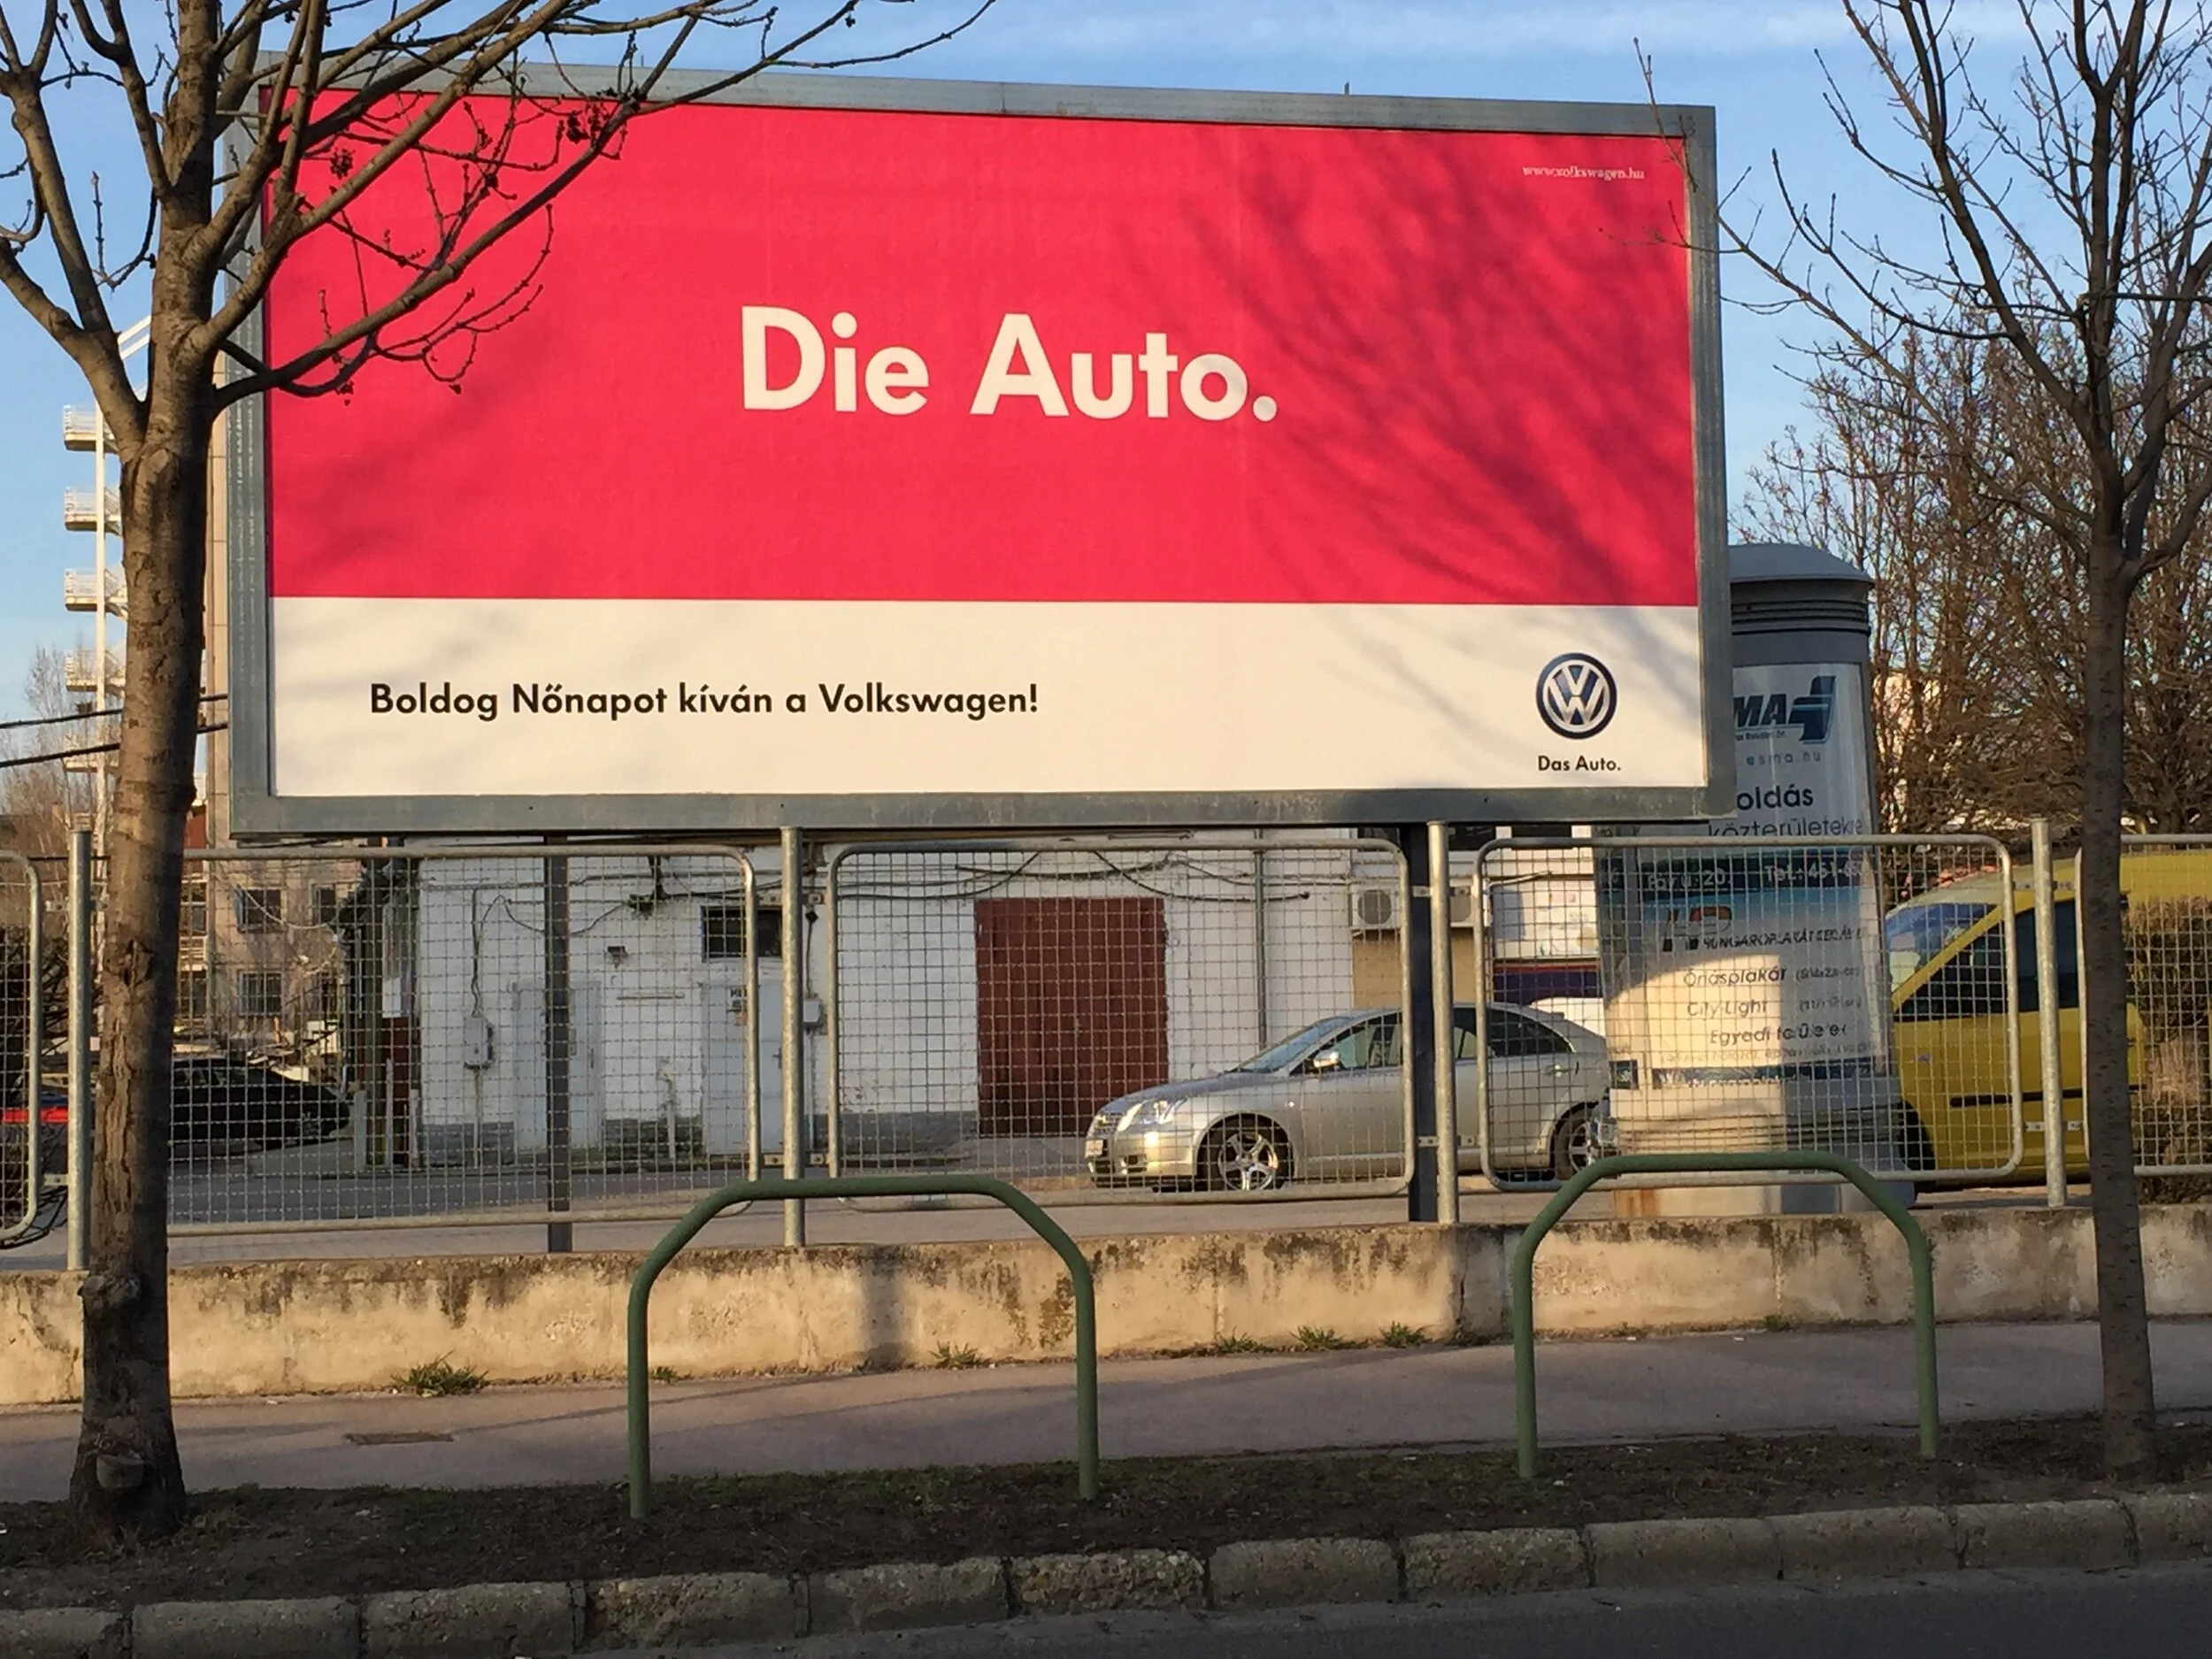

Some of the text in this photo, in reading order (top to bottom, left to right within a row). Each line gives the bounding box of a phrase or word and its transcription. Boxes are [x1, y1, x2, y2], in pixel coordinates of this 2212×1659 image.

[741, 305, 1278, 422] Die Auto.
[371, 680, 1038, 722] Boldog Nőnapot kíván a Volkswagen!
[1538, 755, 1622, 772] Das Auto.
[1736, 783, 1814, 810] oldás
